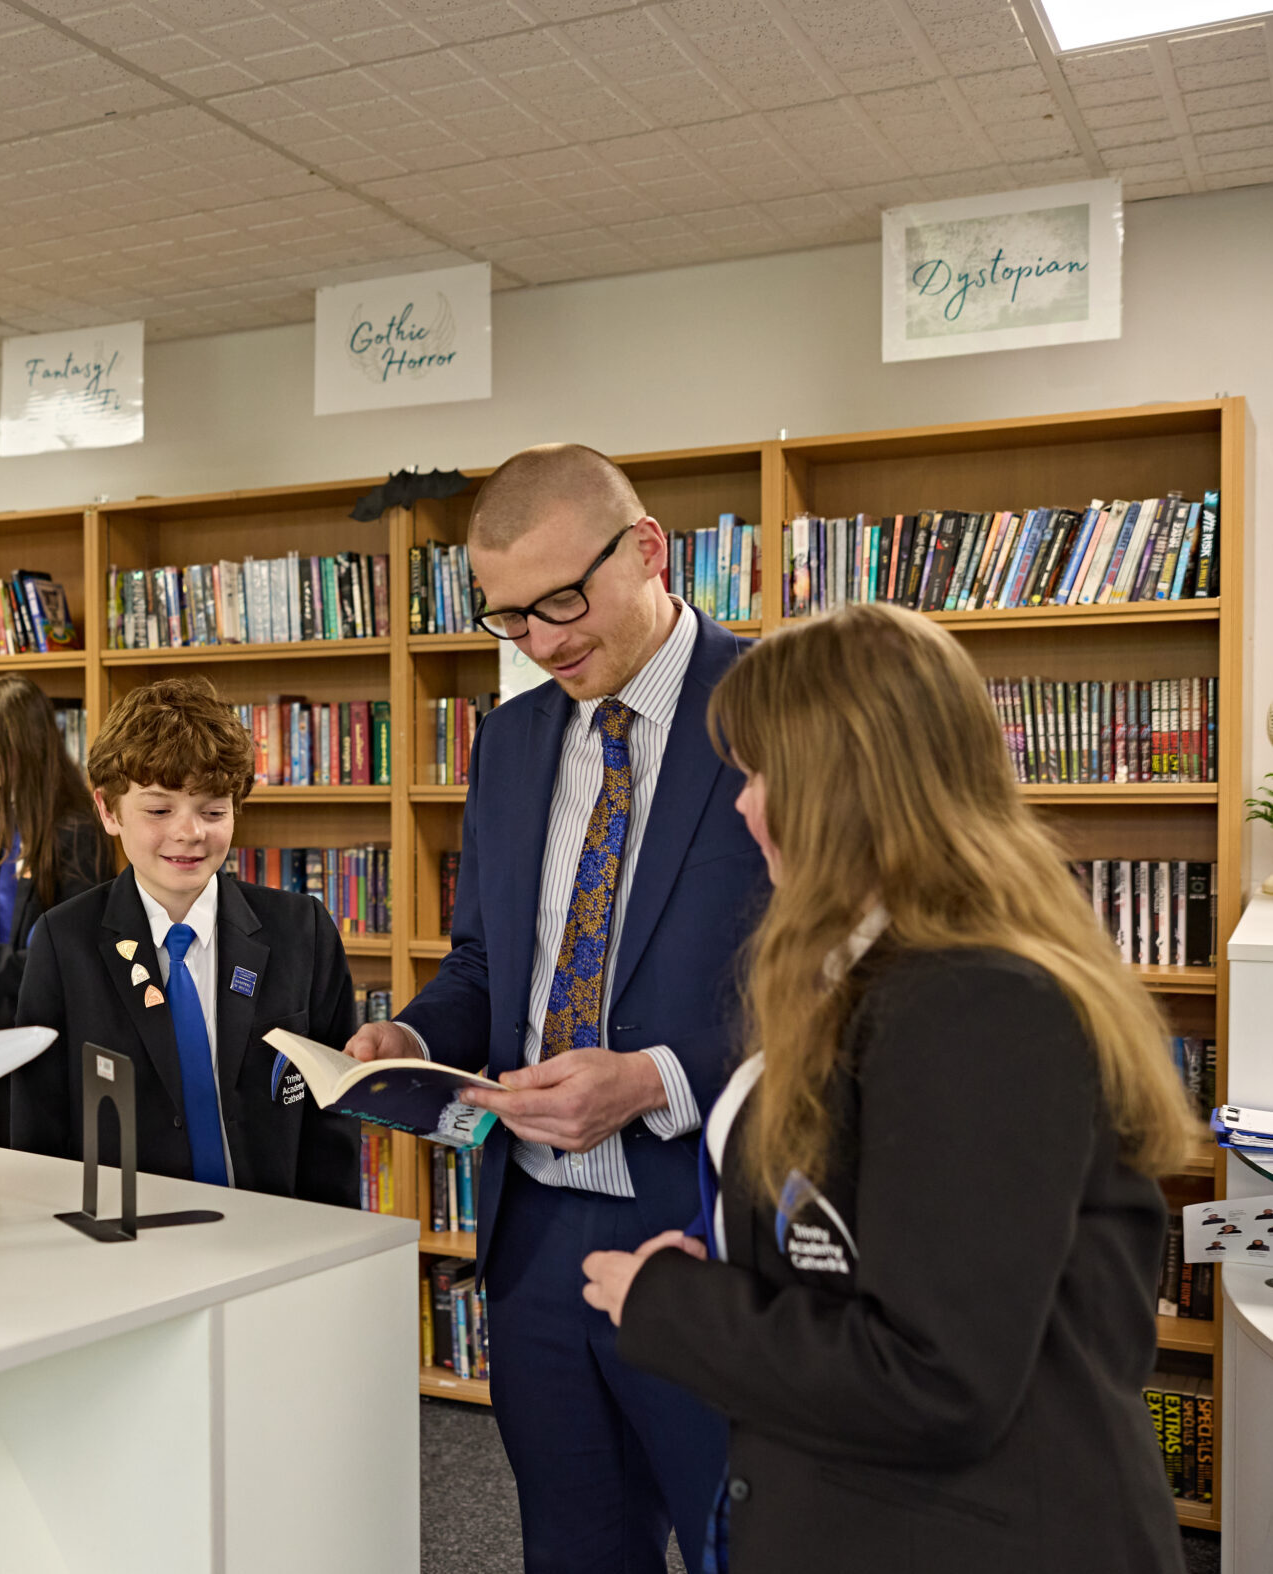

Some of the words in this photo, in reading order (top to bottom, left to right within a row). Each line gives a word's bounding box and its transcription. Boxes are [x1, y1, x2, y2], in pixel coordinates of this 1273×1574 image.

[912, 248, 1089, 321] Dystopian
[350, 302, 431, 355] Gothic
[382, 346, 457, 382] Horror
[1199, 533, 1214, 557] RISK
[285, 1073, 302, 1085] Trinity
[788, 1237, 843, 1260] Academy
[791, 1222, 830, 1243] Trinity
[1164, 1395, 1182, 1454] EXTRAS
[1182, 1400, 1195, 1446] SPECIALS
[1197, 1399, 1214, 1463] SPECIALS
